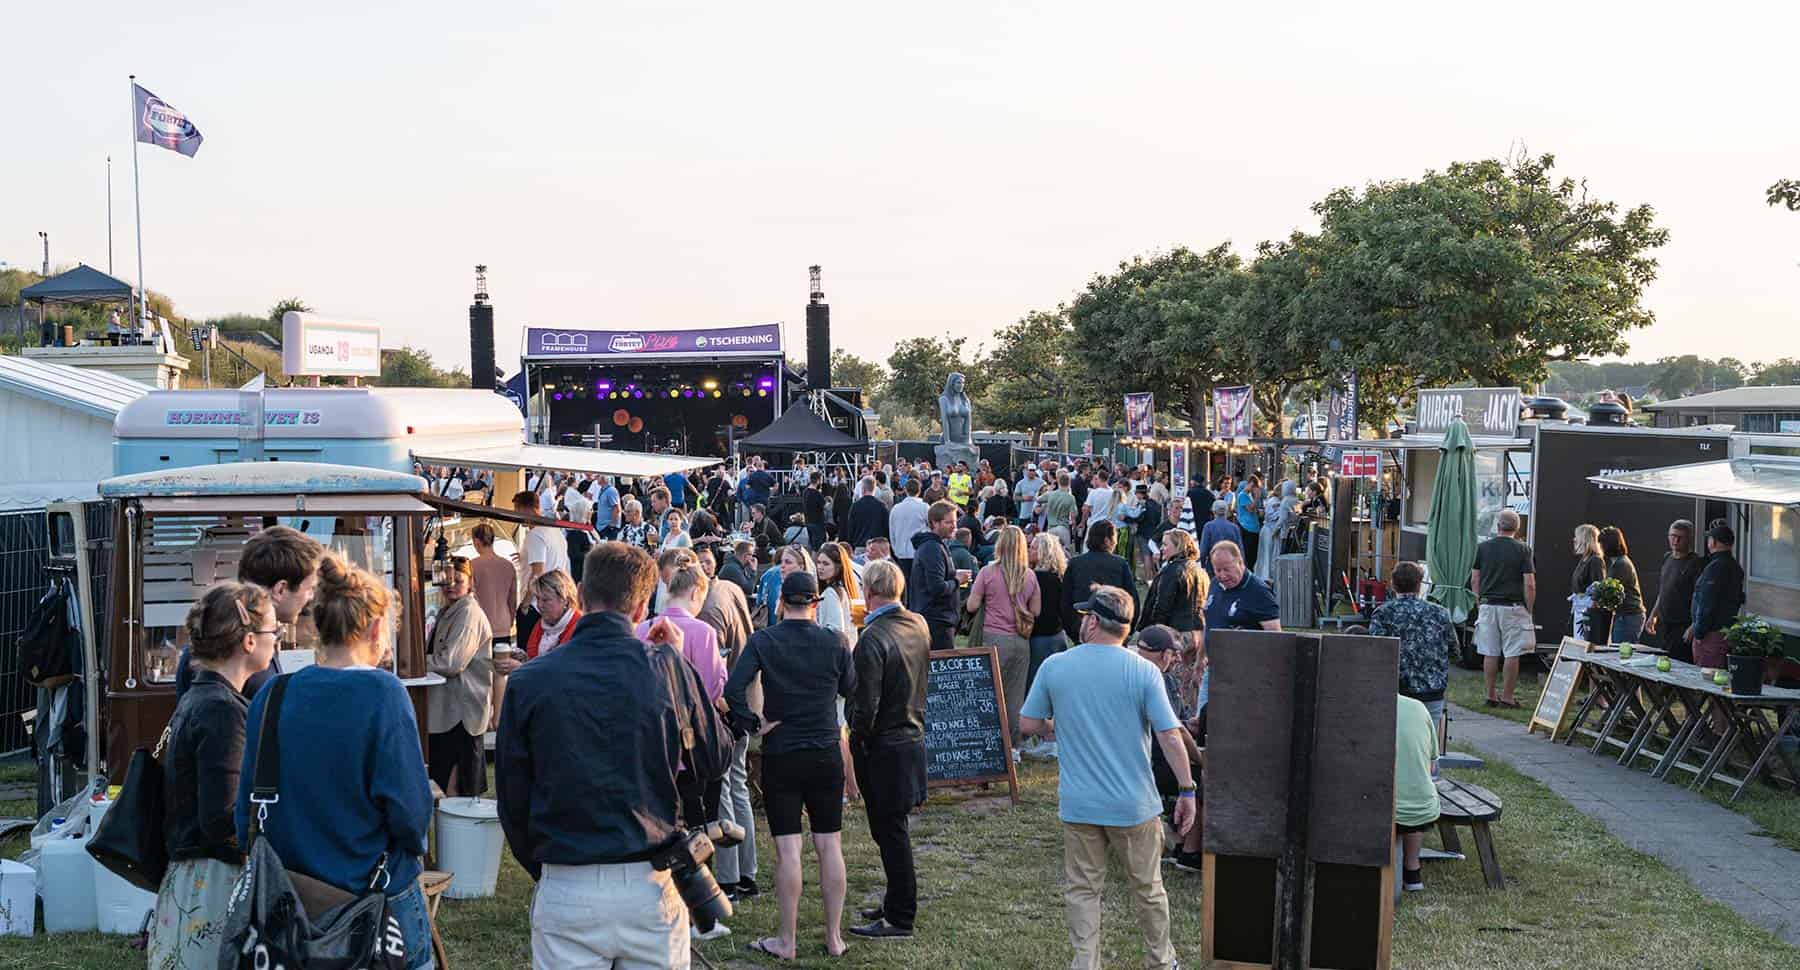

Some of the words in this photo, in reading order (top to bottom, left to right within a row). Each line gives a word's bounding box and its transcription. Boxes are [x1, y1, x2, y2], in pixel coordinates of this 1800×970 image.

[709, 334, 774, 346] TSCHERNING
[308, 344, 334, 355] UGANDA
[1420, 395, 1463, 428] BURGER
[1483, 393, 1516, 430] JACK
